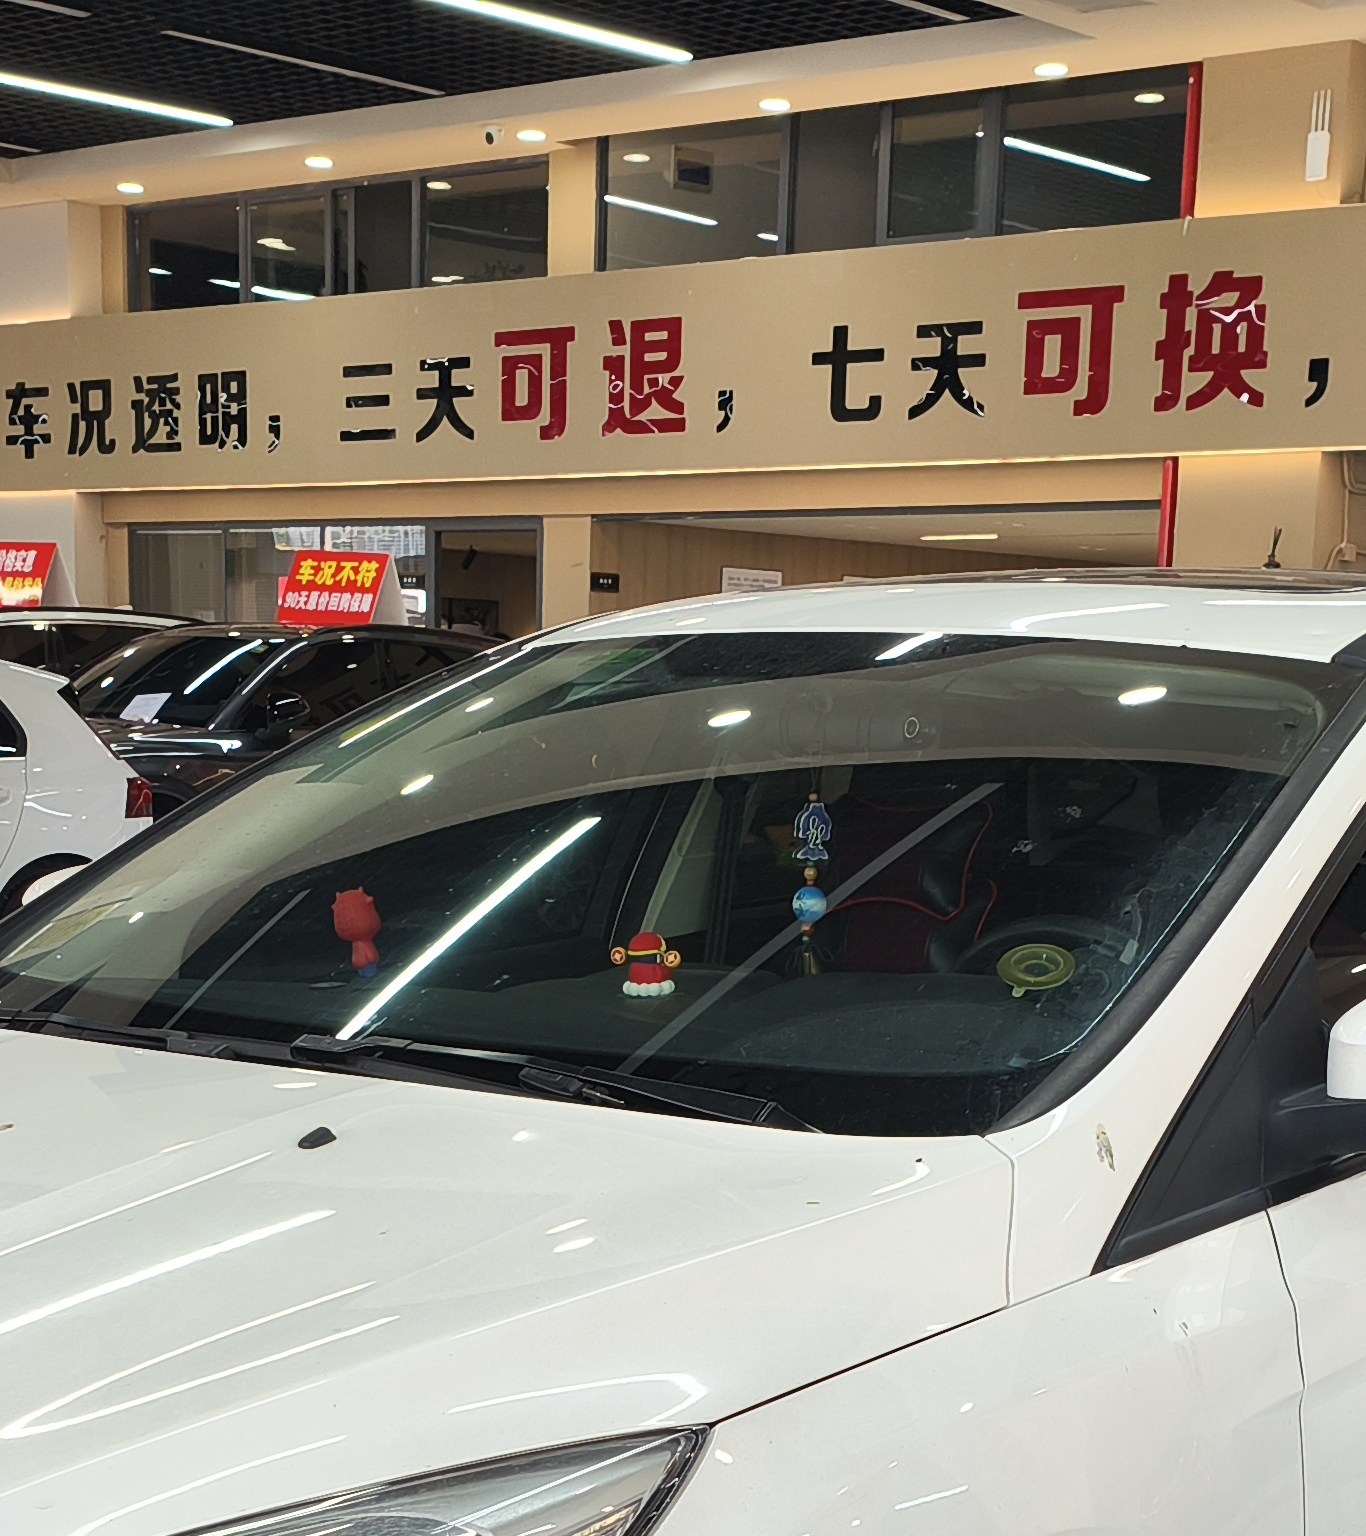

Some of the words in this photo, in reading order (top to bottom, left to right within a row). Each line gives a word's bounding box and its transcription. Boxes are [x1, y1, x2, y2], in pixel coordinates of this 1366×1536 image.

[296, 559, 379, 587] 车况不符
[284, 591, 373, 612] 90天原价回购保障
